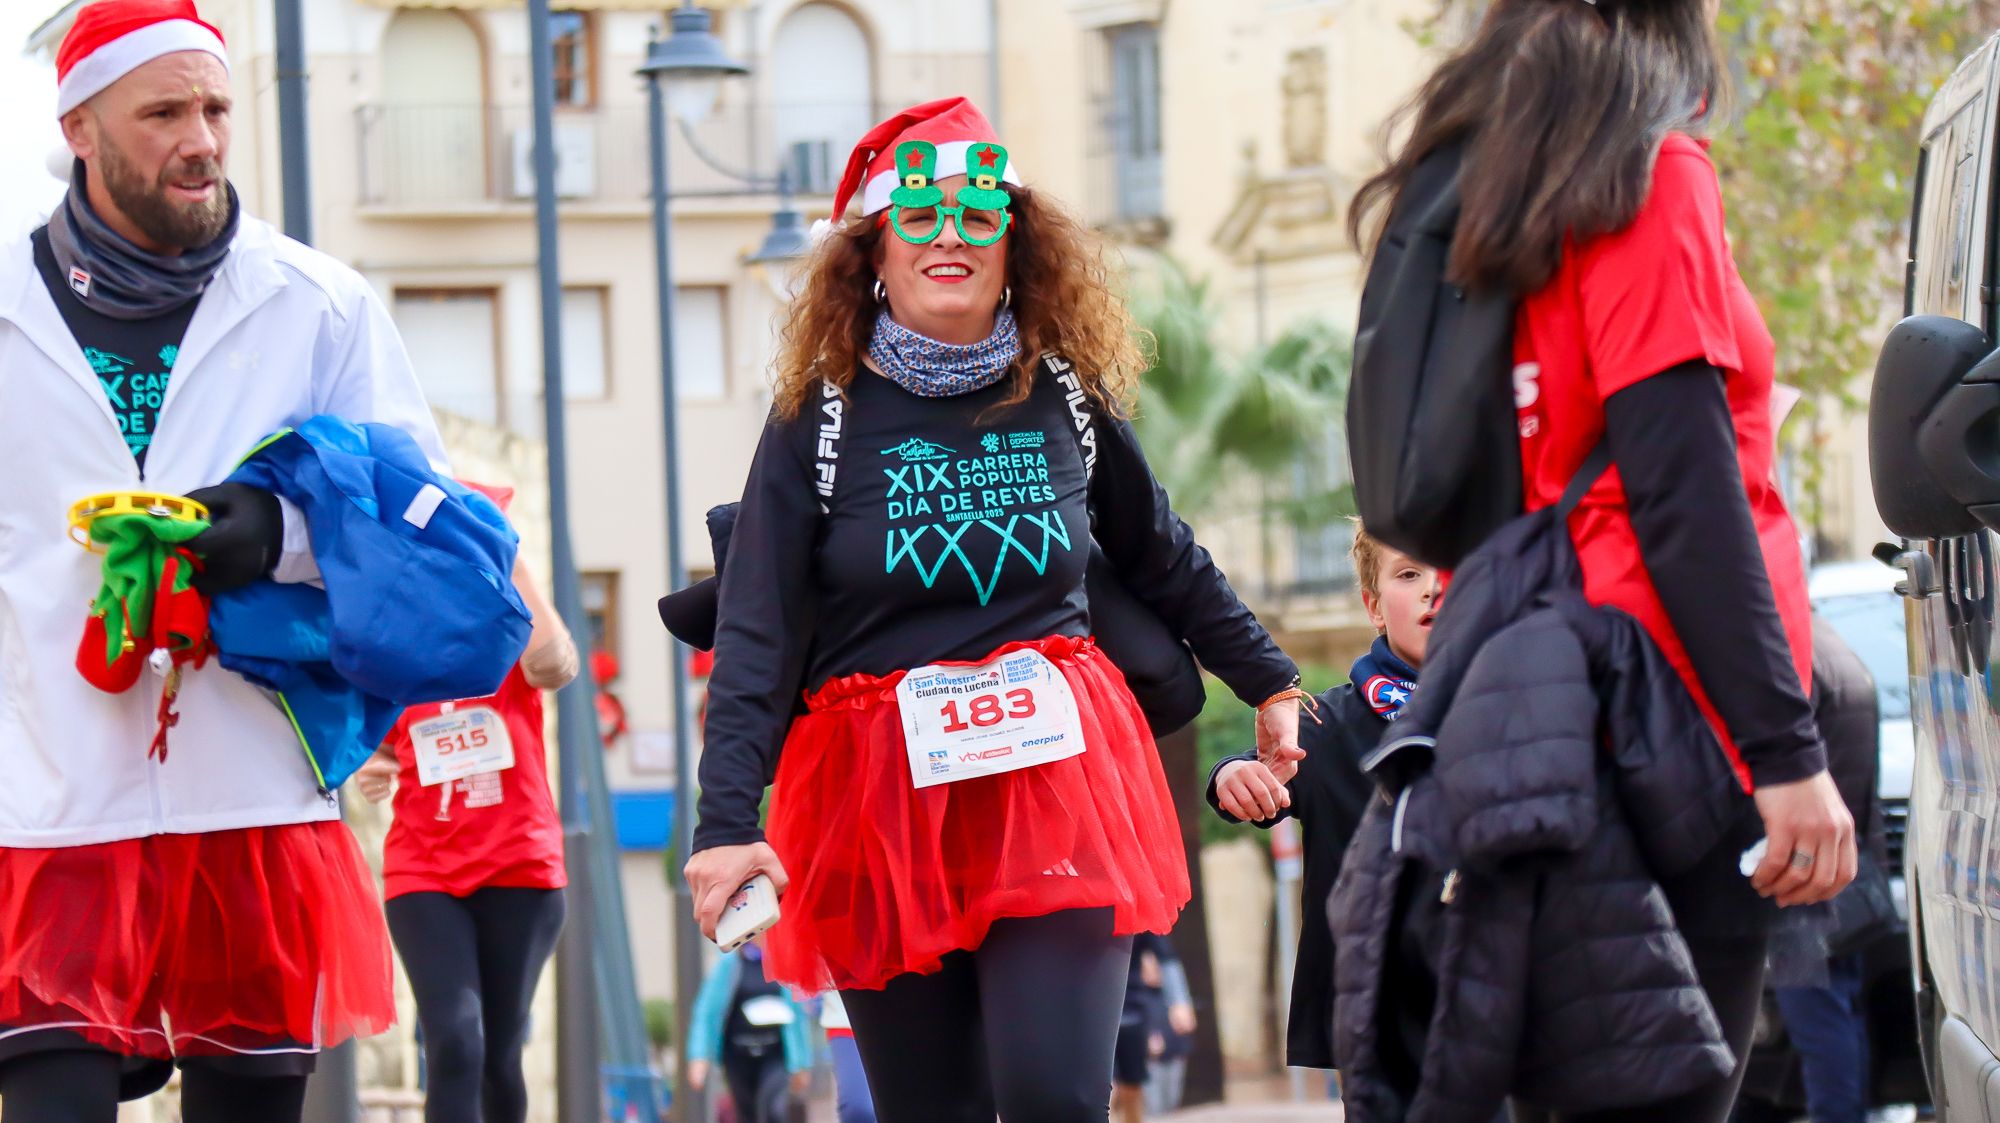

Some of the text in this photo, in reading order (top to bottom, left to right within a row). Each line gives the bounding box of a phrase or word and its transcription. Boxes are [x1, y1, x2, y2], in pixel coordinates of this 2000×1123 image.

[1057, 371, 1091, 431] FILA
[817, 400, 842, 459] FILA
[1009, 436, 1045, 446] DEPORTES
[883, 453, 1048, 498] XIX CARRERA
[959, 468, 1049, 489] POPULAR
[887, 485, 1056, 520] DÍA DE REYES
[945, 508, 1004, 523] SANTAELLA 2025
[1005, 655, 1032, 666] MEMORIAL
[1020, 659, 1039, 669] CARLOS
[914, 679, 933, 689] San
[935, 674, 977, 686] Silvestre
[1007, 668, 1033, 678] HURTADO
[916, 686, 949, 698] Ciudad
[965, 680, 999, 693] Lucena
[940, 688, 1036, 733] 183
[436, 729, 488, 755] 515
[1021, 732, 1064, 748] enerplus
